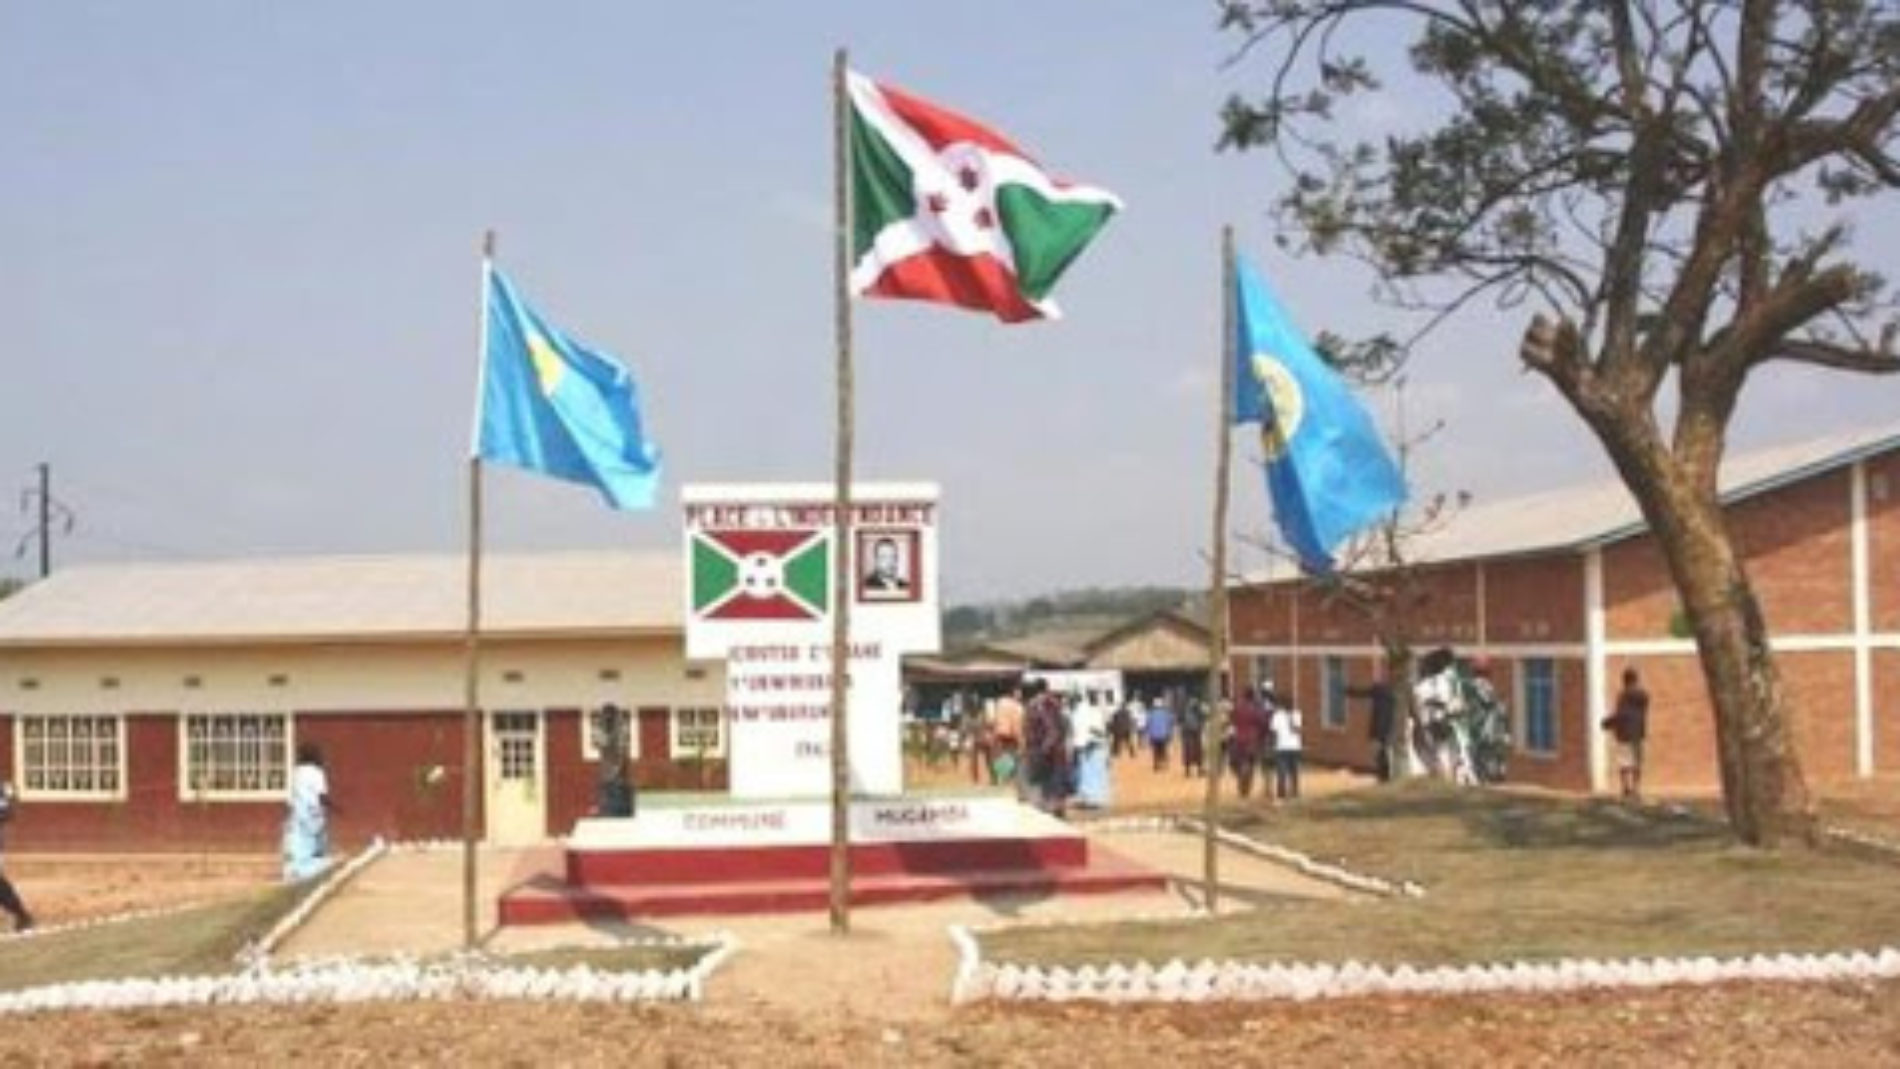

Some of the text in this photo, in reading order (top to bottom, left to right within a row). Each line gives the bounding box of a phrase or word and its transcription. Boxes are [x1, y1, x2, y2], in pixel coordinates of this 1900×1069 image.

[685, 503, 745, 528] PLACE
[772, 502, 938, 527] L'INDENDANCE
[682, 811, 787, 831] COMMUNE
